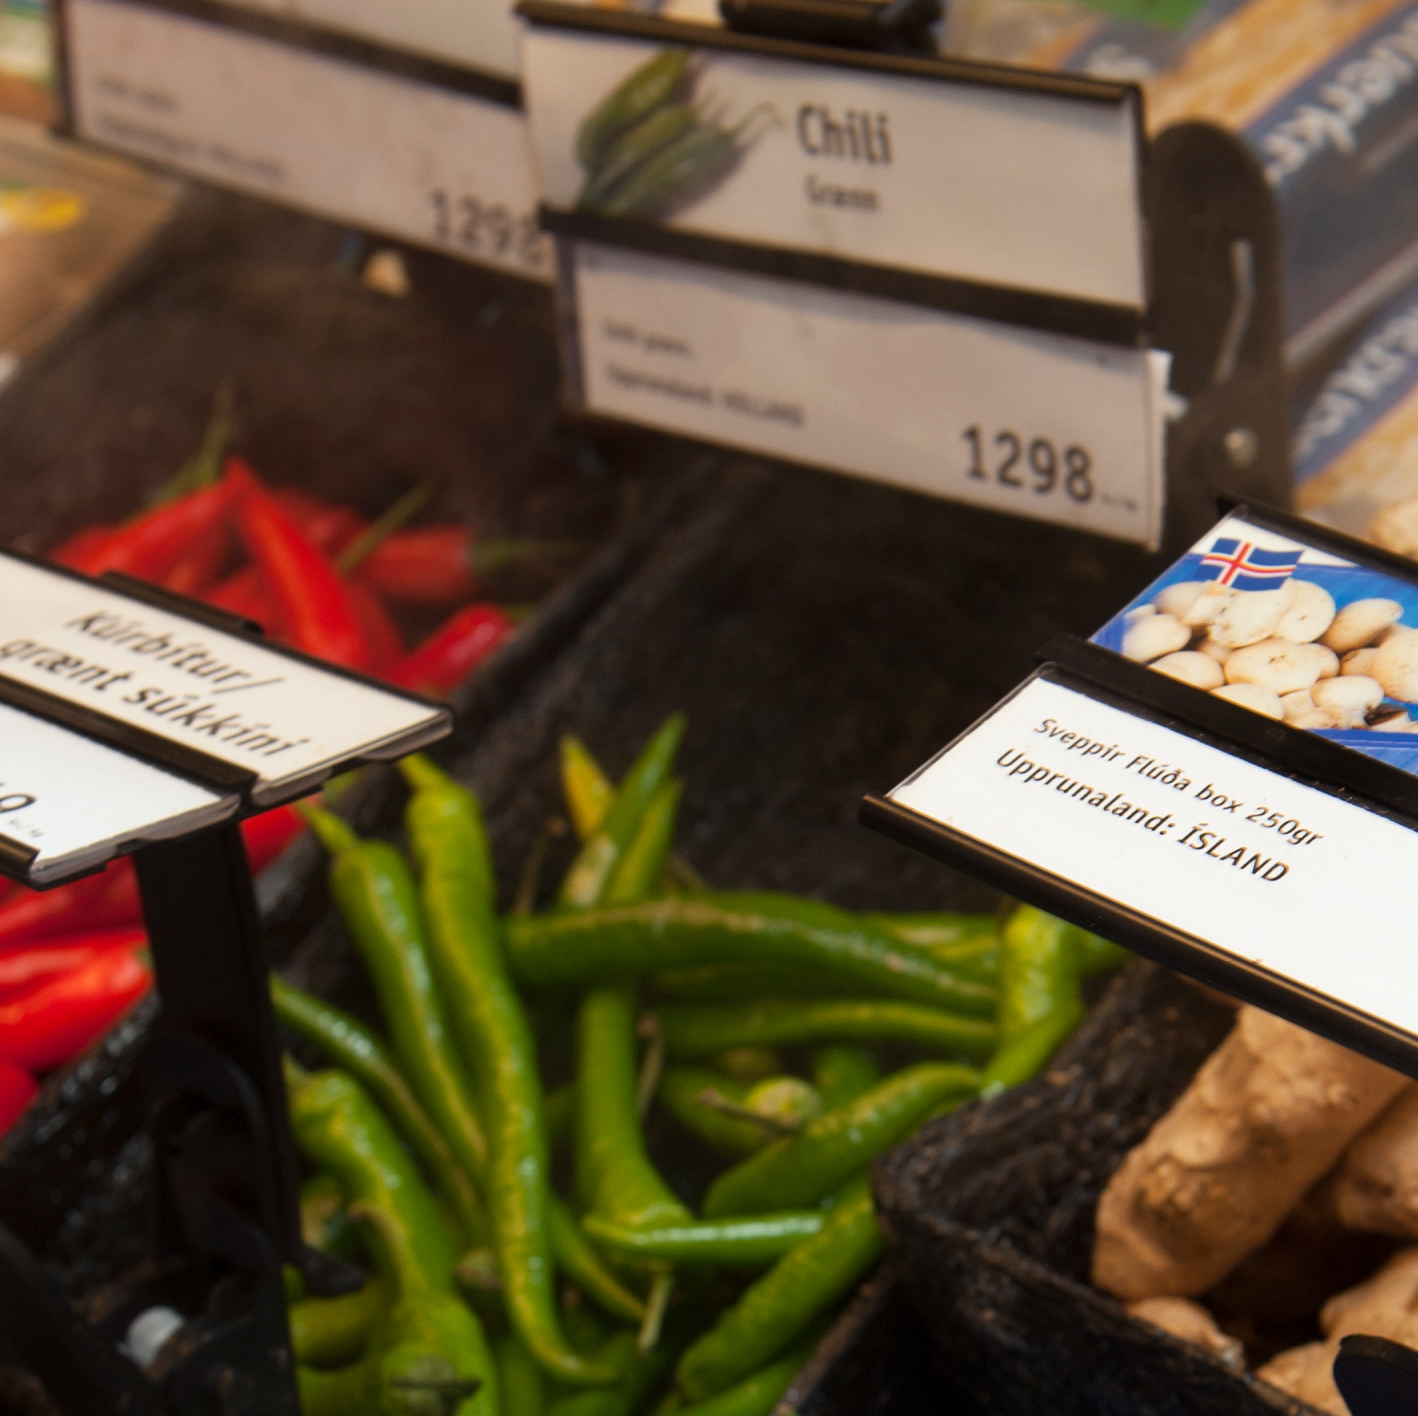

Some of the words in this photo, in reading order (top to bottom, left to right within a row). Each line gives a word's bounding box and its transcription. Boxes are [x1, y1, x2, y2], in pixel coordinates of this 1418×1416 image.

[798, 103, 892, 165] Chili
[963, 423, 1094, 504] 1298
[995, 747, 1176, 836] Upprunaland:
[1176, 823, 1290, 883] ÍSLAND
[1033, 717, 1125, 763] Sveppir
[1125, 753, 1193, 792] Flúða
[1194, 783, 1244, 813] box
[1245, 805, 1324, 849] 250gr
